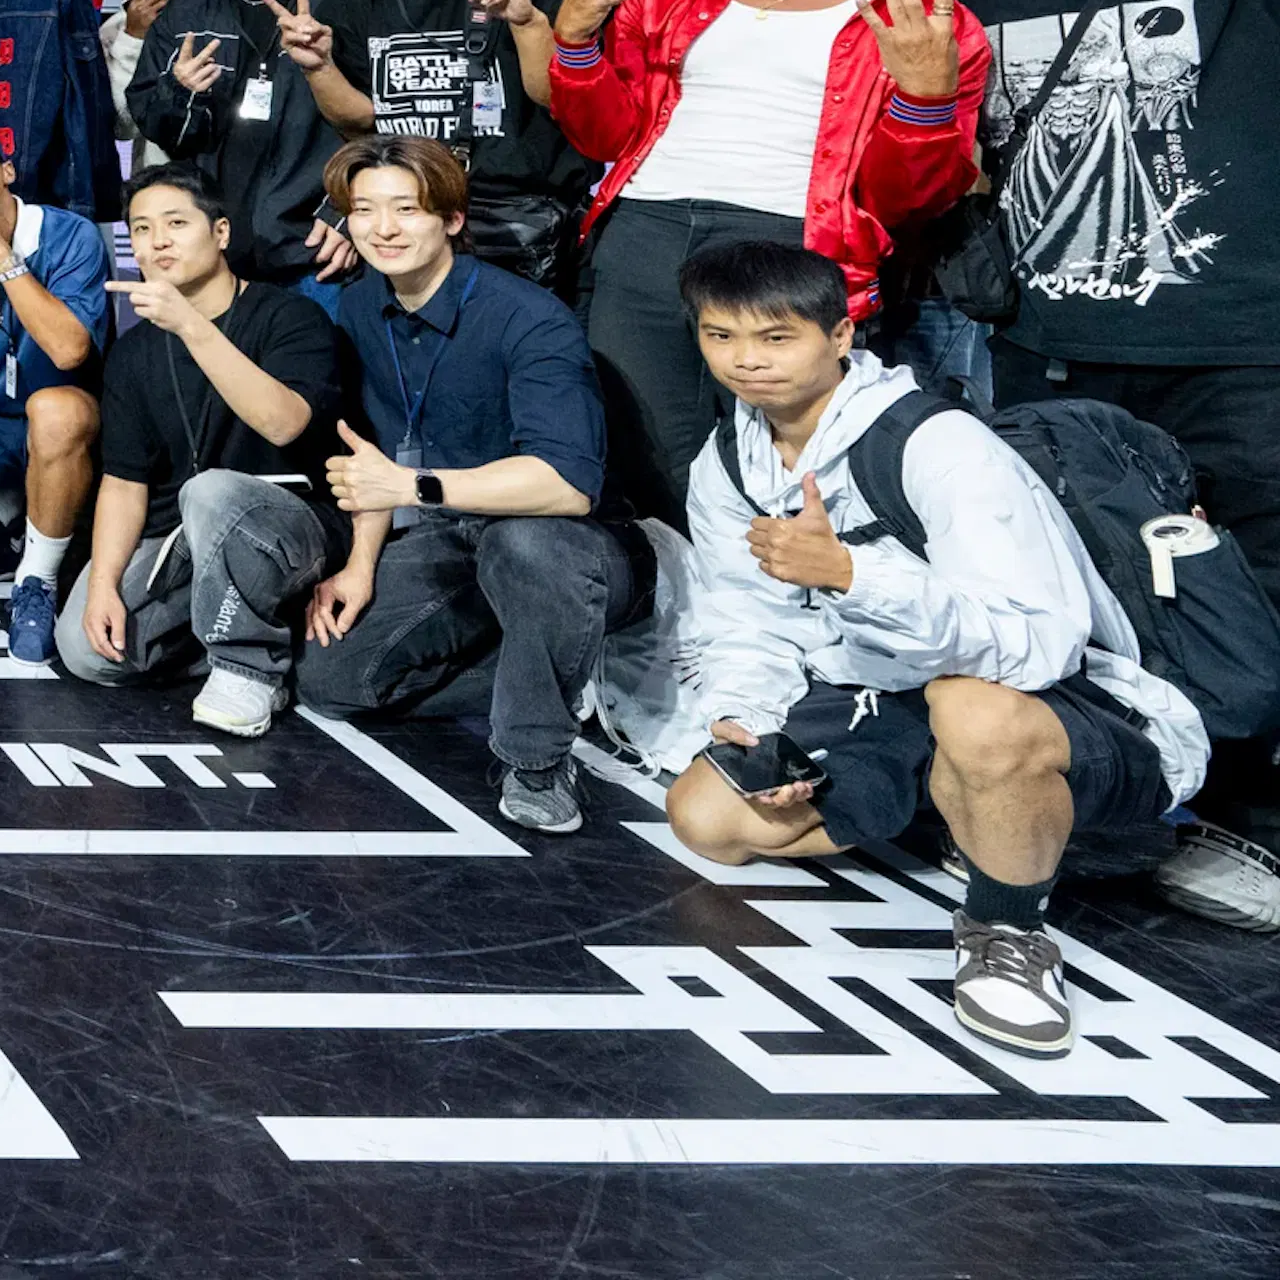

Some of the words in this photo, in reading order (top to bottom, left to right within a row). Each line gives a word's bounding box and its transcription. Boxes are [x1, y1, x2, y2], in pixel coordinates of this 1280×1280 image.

[390, 55, 470, 70] BATTLE
[390, 69, 420, 80] OF
[424, 66, 469, 78] THE
[391, 78, 452, 91] YEAR
[414, 99, 454, 113] KOREA
